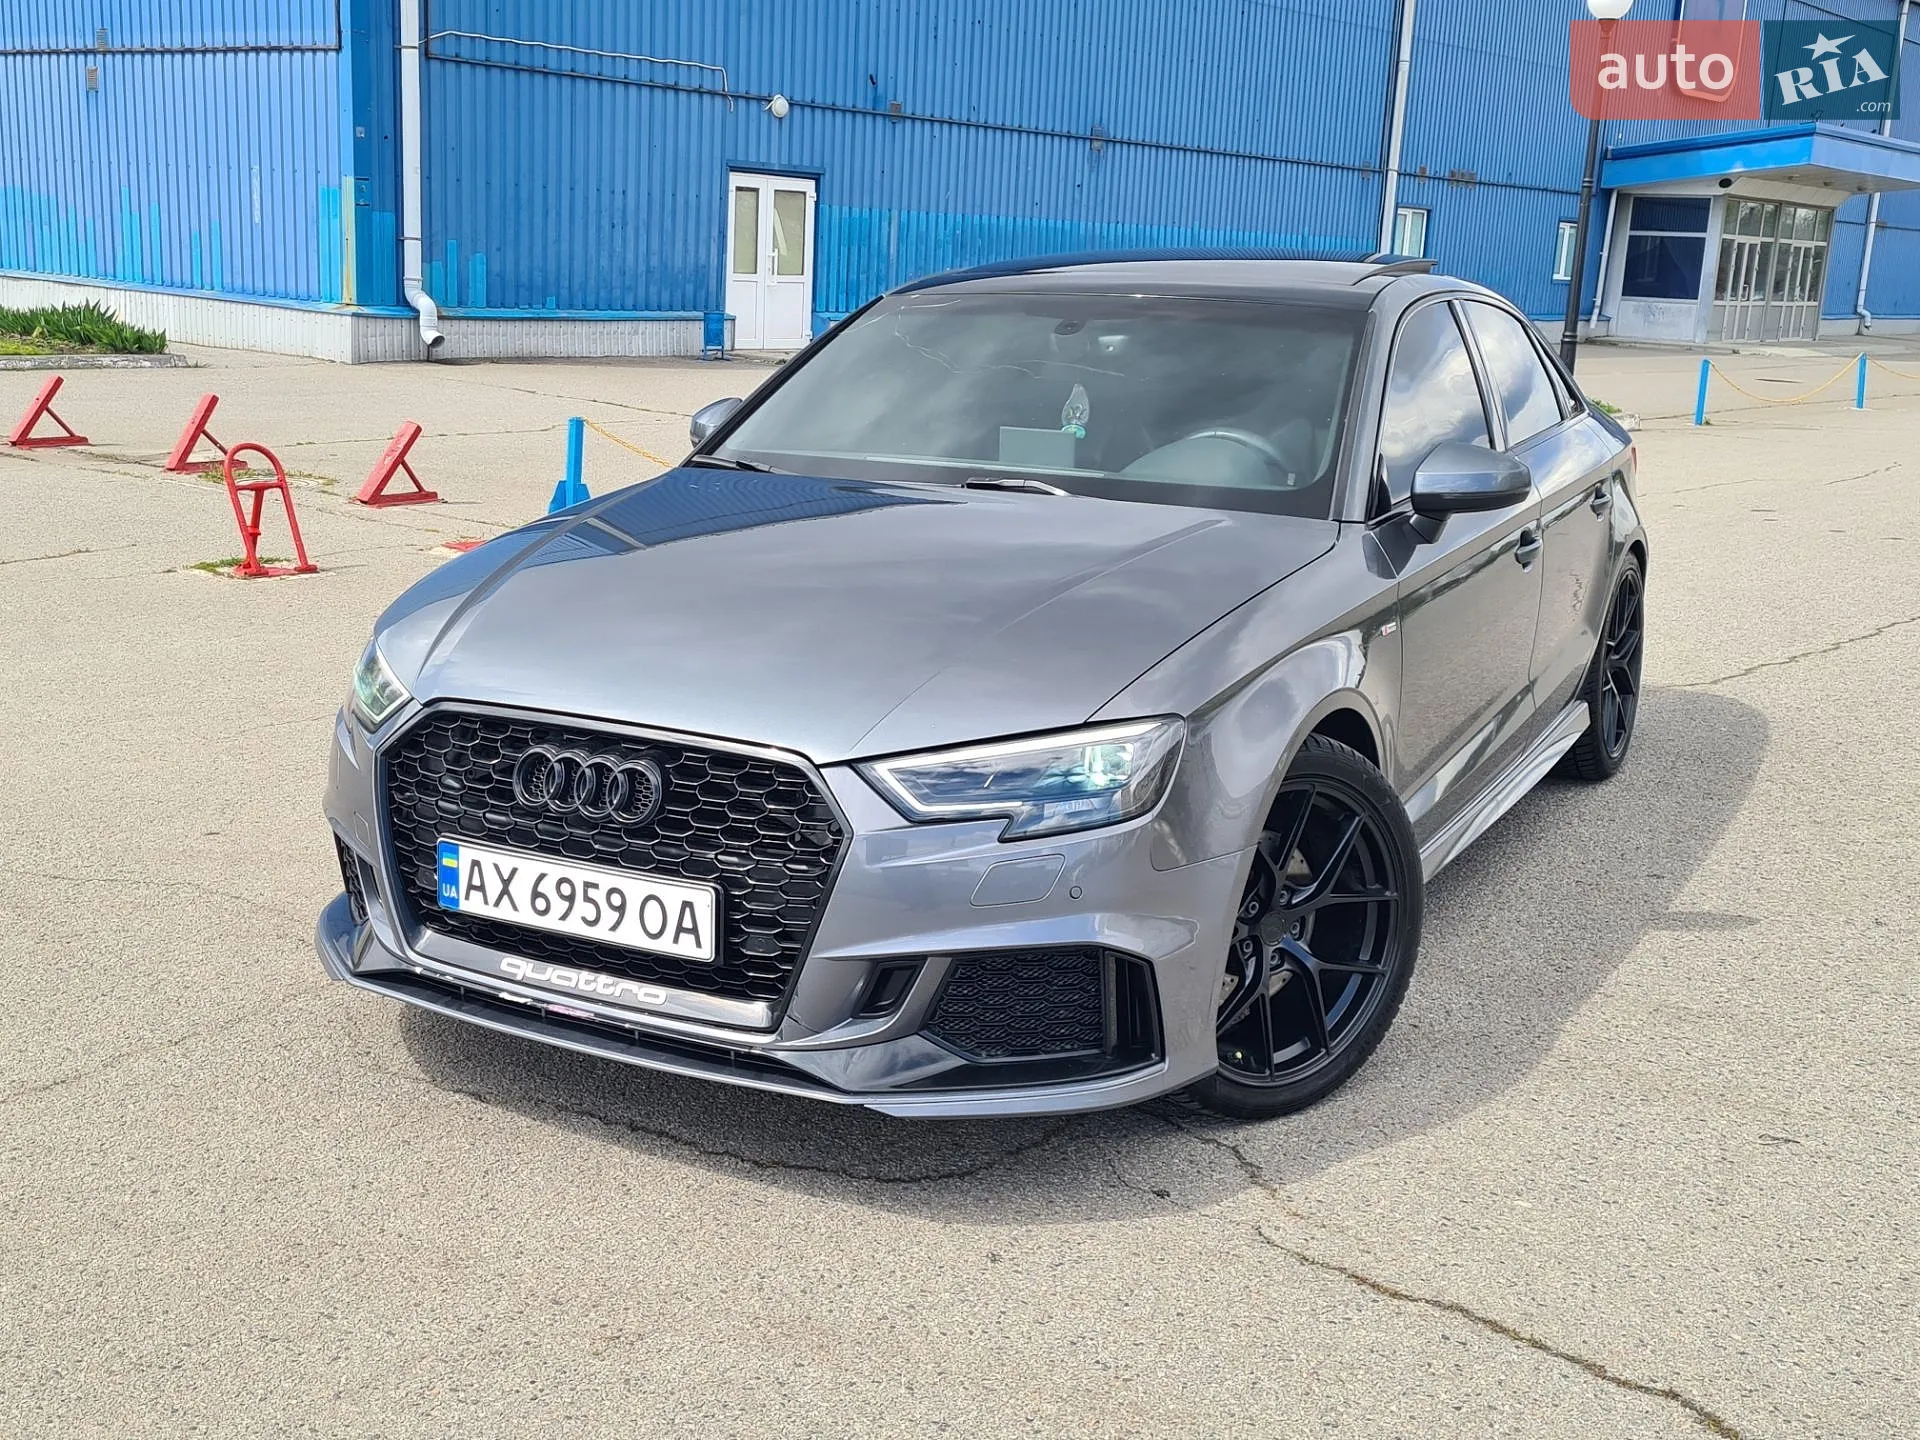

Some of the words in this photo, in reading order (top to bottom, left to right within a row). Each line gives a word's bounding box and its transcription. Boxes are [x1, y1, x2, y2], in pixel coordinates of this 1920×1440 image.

[442, 883, 458, 899] UA
[464, 858, 519, 913] AX
[530, 872, 627, 933] 6959
[638, 893, 702, 949] OA
[500, 956, 668, 1006] quattro
